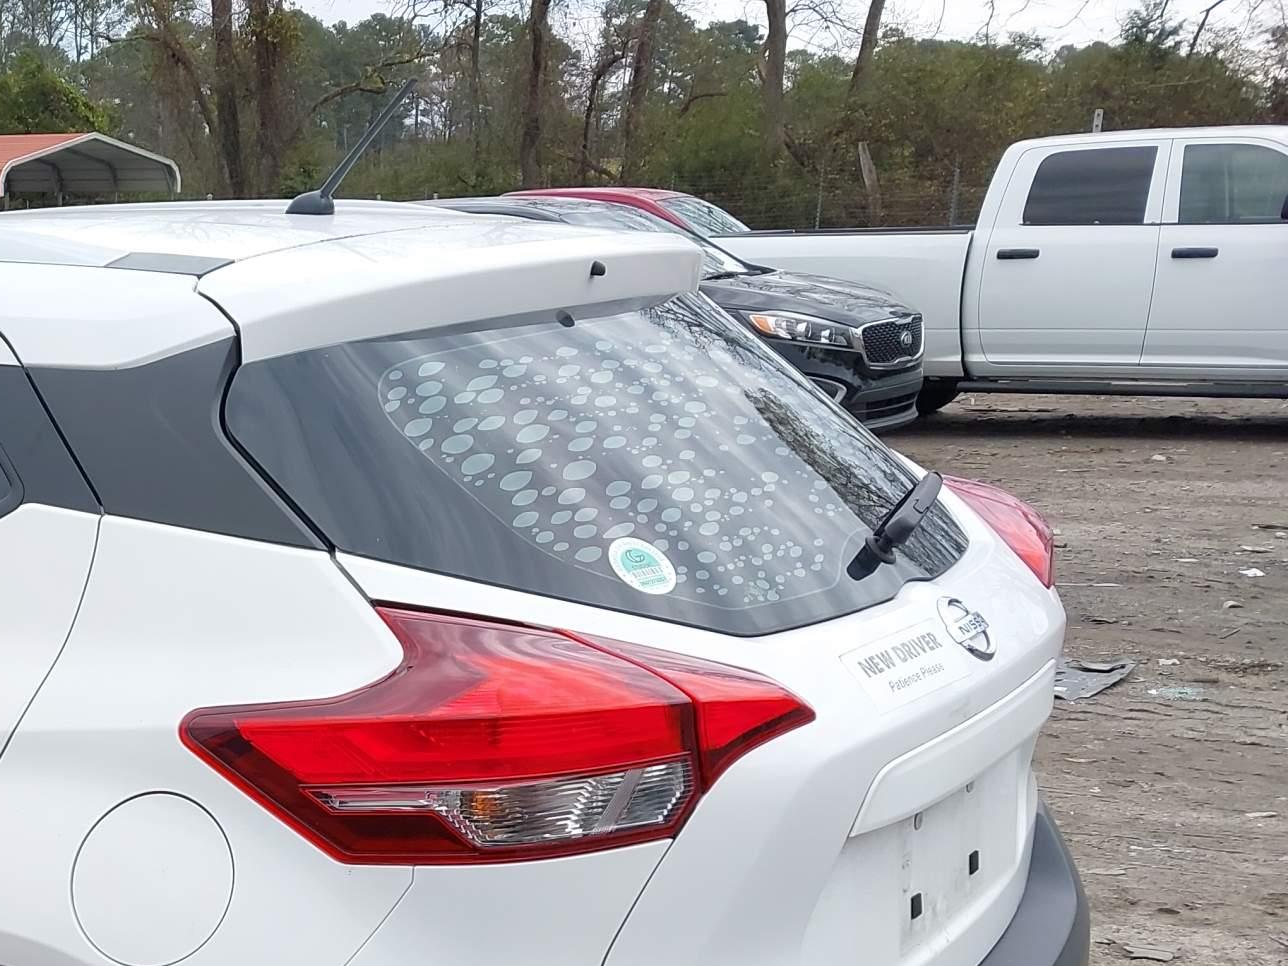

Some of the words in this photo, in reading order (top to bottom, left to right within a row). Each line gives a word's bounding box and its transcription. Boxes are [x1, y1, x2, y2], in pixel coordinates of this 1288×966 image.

[958, 613, 985, 636] NISS
[857, 650, 896, 678] NEW
[891, 632, 943, 663] DRIVER
[889, 673, 922, 693] Patience
[920, 663, 945, 679] Please
